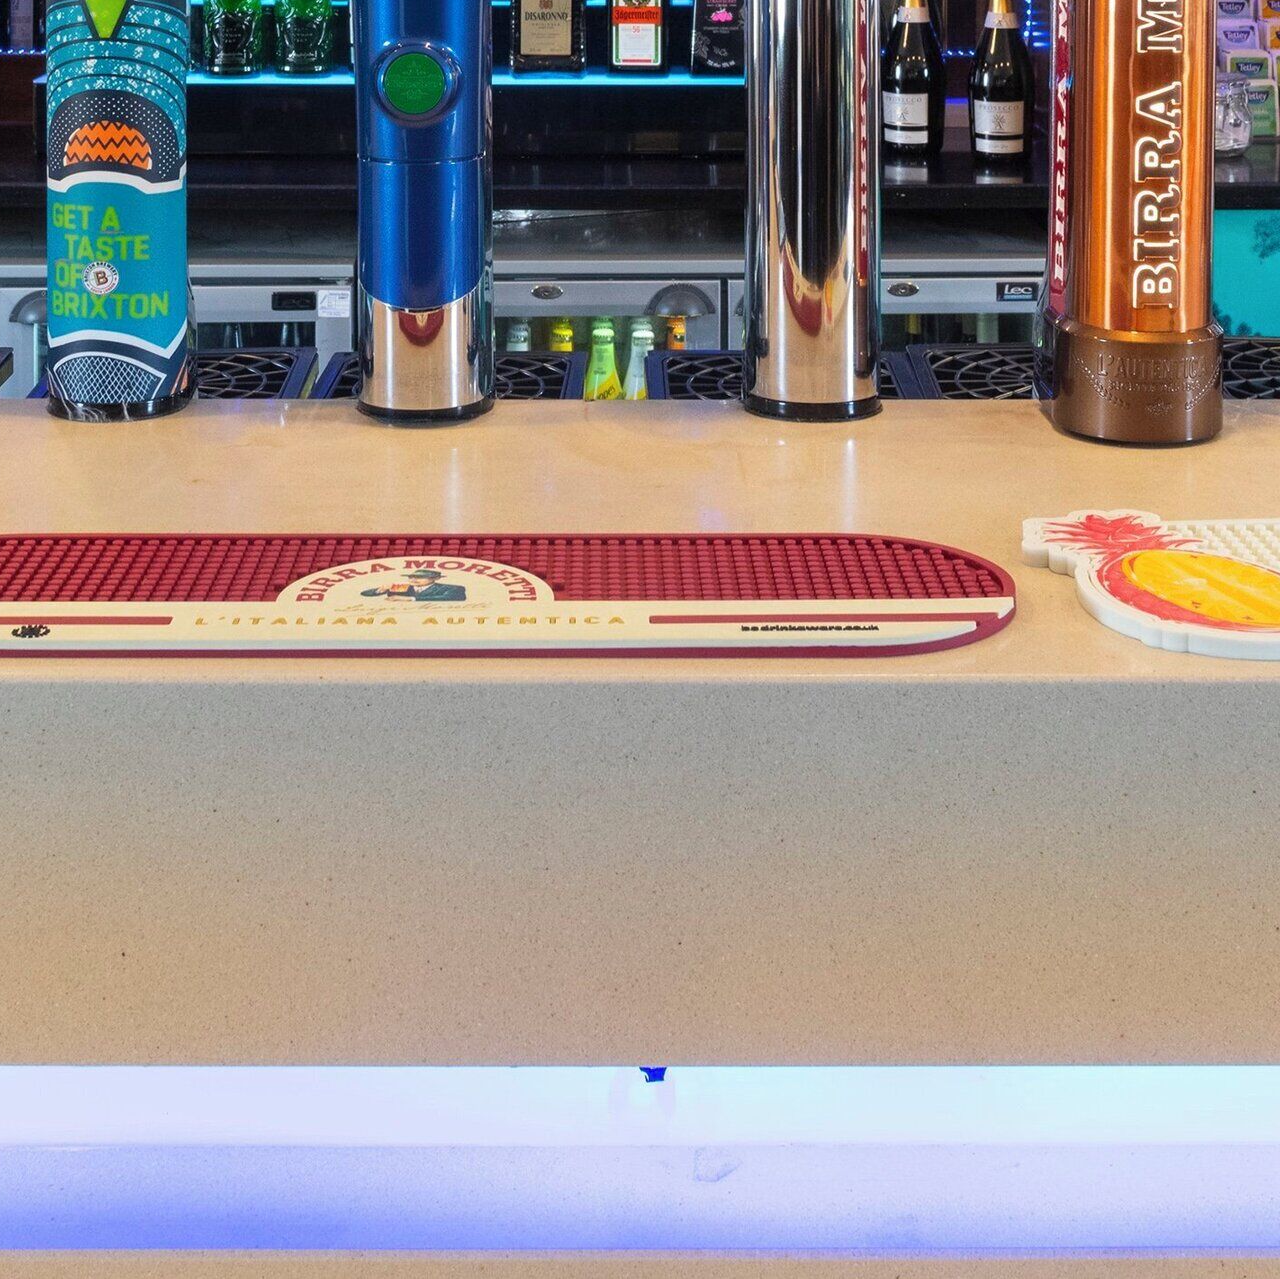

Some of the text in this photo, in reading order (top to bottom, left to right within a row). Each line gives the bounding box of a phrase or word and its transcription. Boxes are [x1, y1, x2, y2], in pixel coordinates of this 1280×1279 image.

[525, 11, 568, 21] DISARONNO
[1221, 3, 1244, 11] Tetley
[1225, 32, 1248, 40] Tetley
[1238, 63, 1261, 71] Tetley
[1053, 74, 1069, 287] BIRRA
[1131, 82, 1187, 309] BIRRA
[52, 203, 120, 231] GET A
[64, 234, 150, 261] TASTE
[55, 260, 85, 288] OF
[1004, 284, 1032, 294] Lec
[52, 290, 169, 320] BRIXTON
[296, 559, 537, 602] BIRRA MORETTI
[195, 616, 625, 625] L'ITALIANA AUTENTICA
